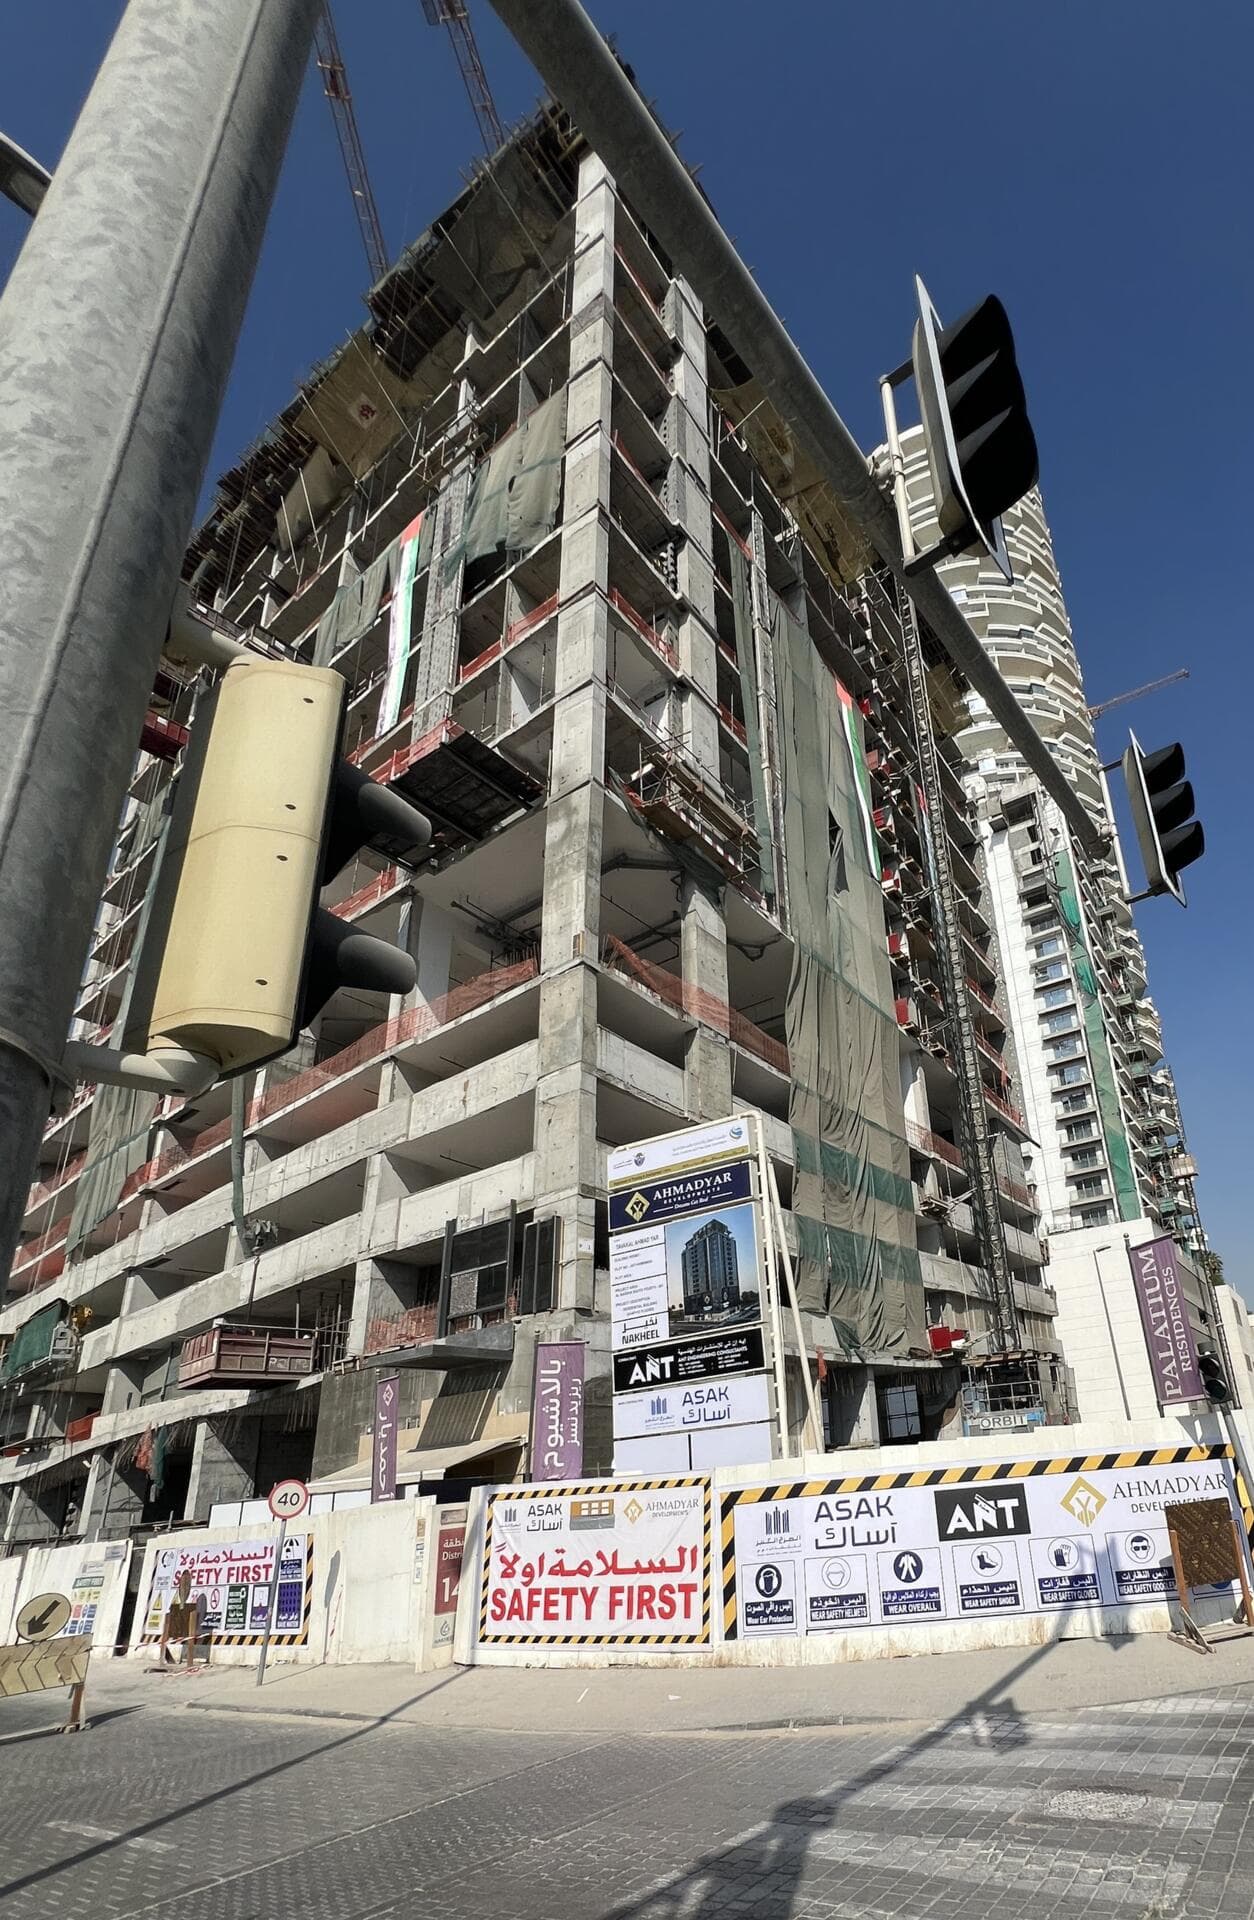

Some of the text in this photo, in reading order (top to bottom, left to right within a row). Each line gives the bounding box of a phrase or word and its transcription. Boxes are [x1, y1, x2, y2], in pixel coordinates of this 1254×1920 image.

[653, 1172, 732, 1200] AHMADYAR
[1138, 1247, 1182, 1397] PALATIUM
[1162, 1266, 1192, 1372] RESIDENCES
[622, 1329, 660, 1345] NAKHEEL
[629, 1354, 674, 1384] ANT
[682, 1386, 729, 1407] ASAK
[980, 1416, 1026, 1429] ORBIT
[1113, 1473, 1228, 1499] AHMADYAR
[278, 1492, 300, 1507] 40
[645, 1498, 699, 1512] AHMADYAR
[814, 1496, 894, 1522] ASAK
[528, 1503, 562, 1517] ASAK
[652, 1510, 689, 1518] DEVELOPMENTS
[947, 1494, 1020, 1534] ANT
[200, 1545, 274, 1564] السلامة
[548, 1544, 698, 1578] السلامة
[173, 1568, 223, 1587] SFETY
[227, 1564, 273, 1583] FIRST
[1043, 1589, 1098, 1601] WEAR SAFETY GLOVES
[1120, 1585, 1133, 1594] WEAR
[1134, 1583, 1152, 1593] SAFETY
[491, 1583, 698, 1621] SAFETY FIRST
[888, 1602, 938, 1614] WEAR OVERALL
[964, 1596, 1016, 1608] WEAR SAFETY SHOES
[811, 1607, 867, 1620] WEAR SAFETY HELMETS
